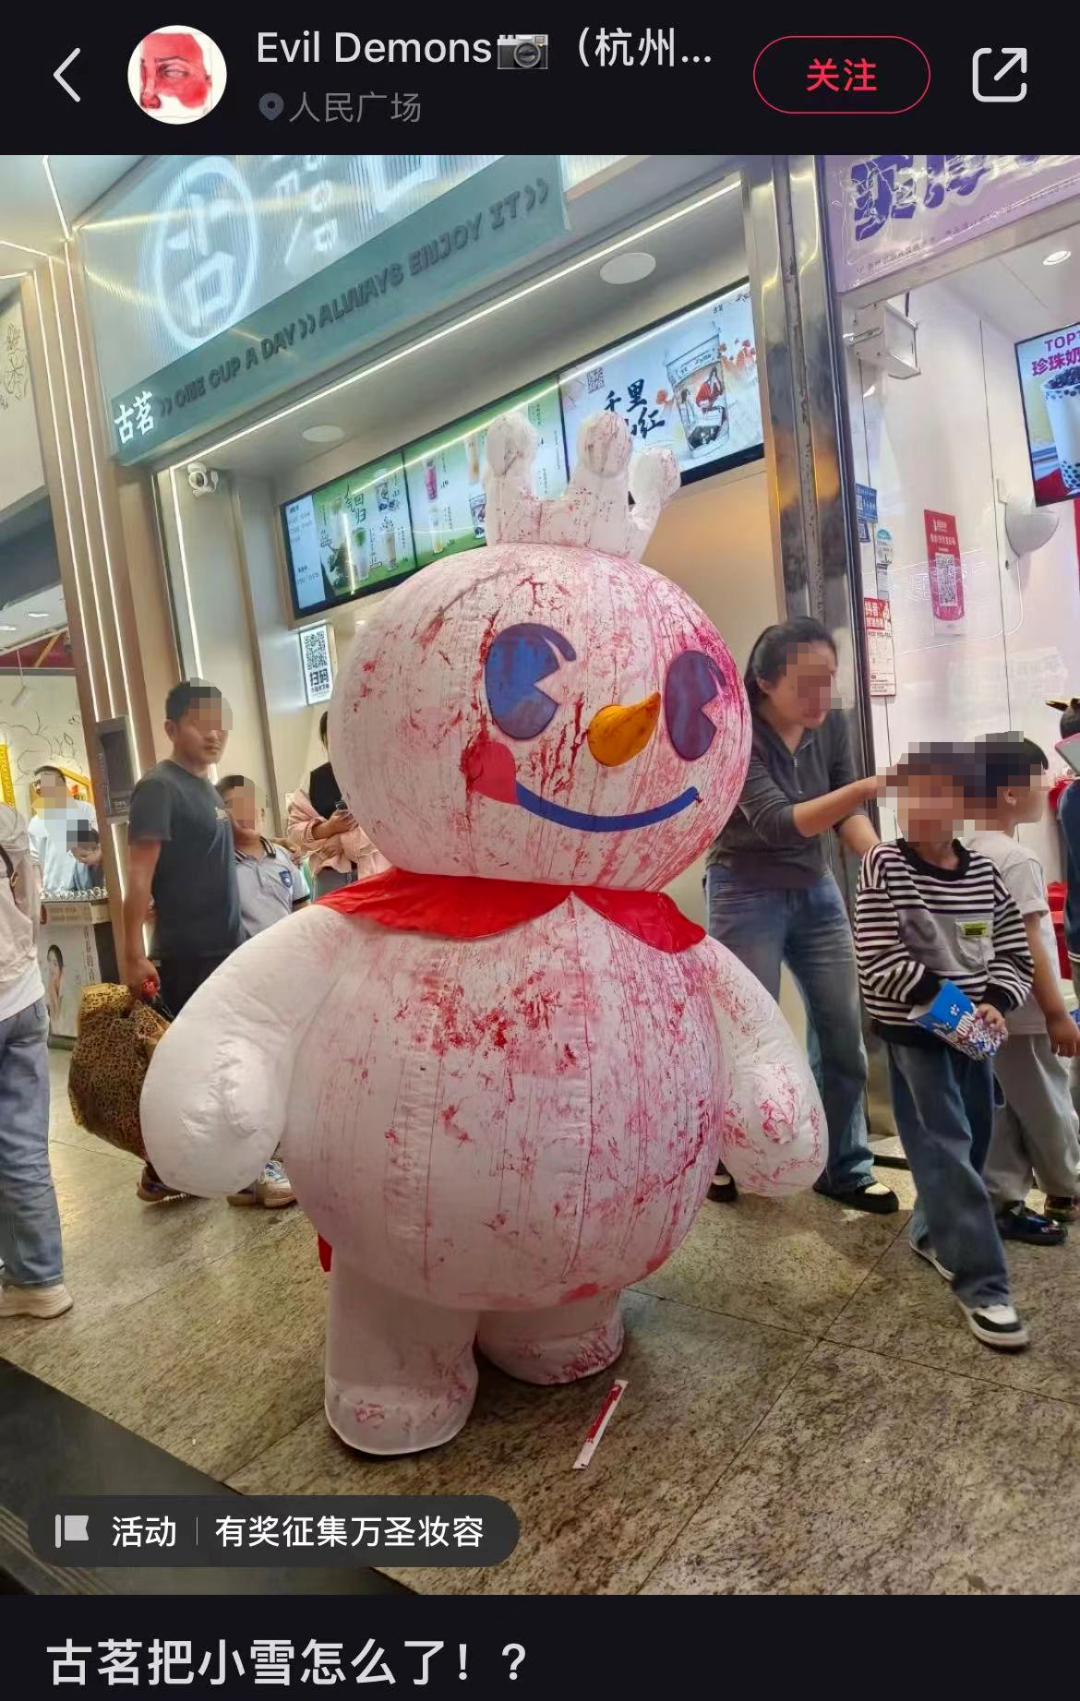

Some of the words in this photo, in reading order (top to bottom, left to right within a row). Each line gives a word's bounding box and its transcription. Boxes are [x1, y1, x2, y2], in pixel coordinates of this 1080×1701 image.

[174, 376, 207, 408] ONE
[208, 357, 241, 389] CUP
[246, 347, 259, 370] A
[261, 323, 296, 360] DAY
[318, 263, 405, 328] ALWAYS
[408, 212, 483, 276] ENJOY
[489, 190, 522, 231] IT
[114, 390, 155, 444] 古茗
